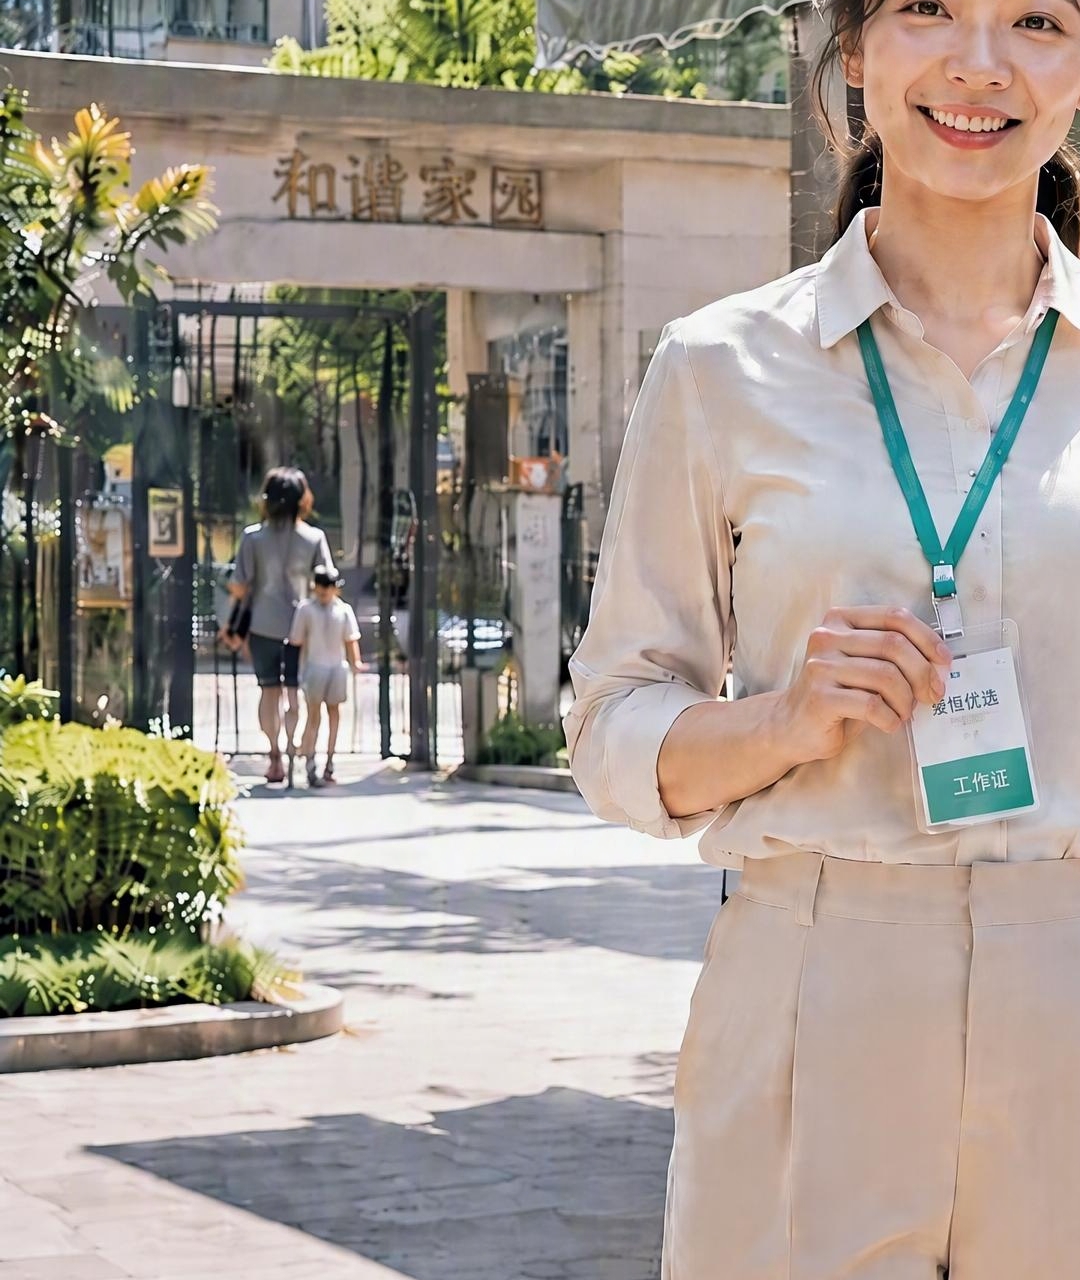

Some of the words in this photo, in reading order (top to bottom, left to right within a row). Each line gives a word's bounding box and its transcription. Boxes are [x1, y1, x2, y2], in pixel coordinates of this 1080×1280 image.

[272, 148, 546, 231] 和谐家园
[953, 769, 1010, 796] 工作证
